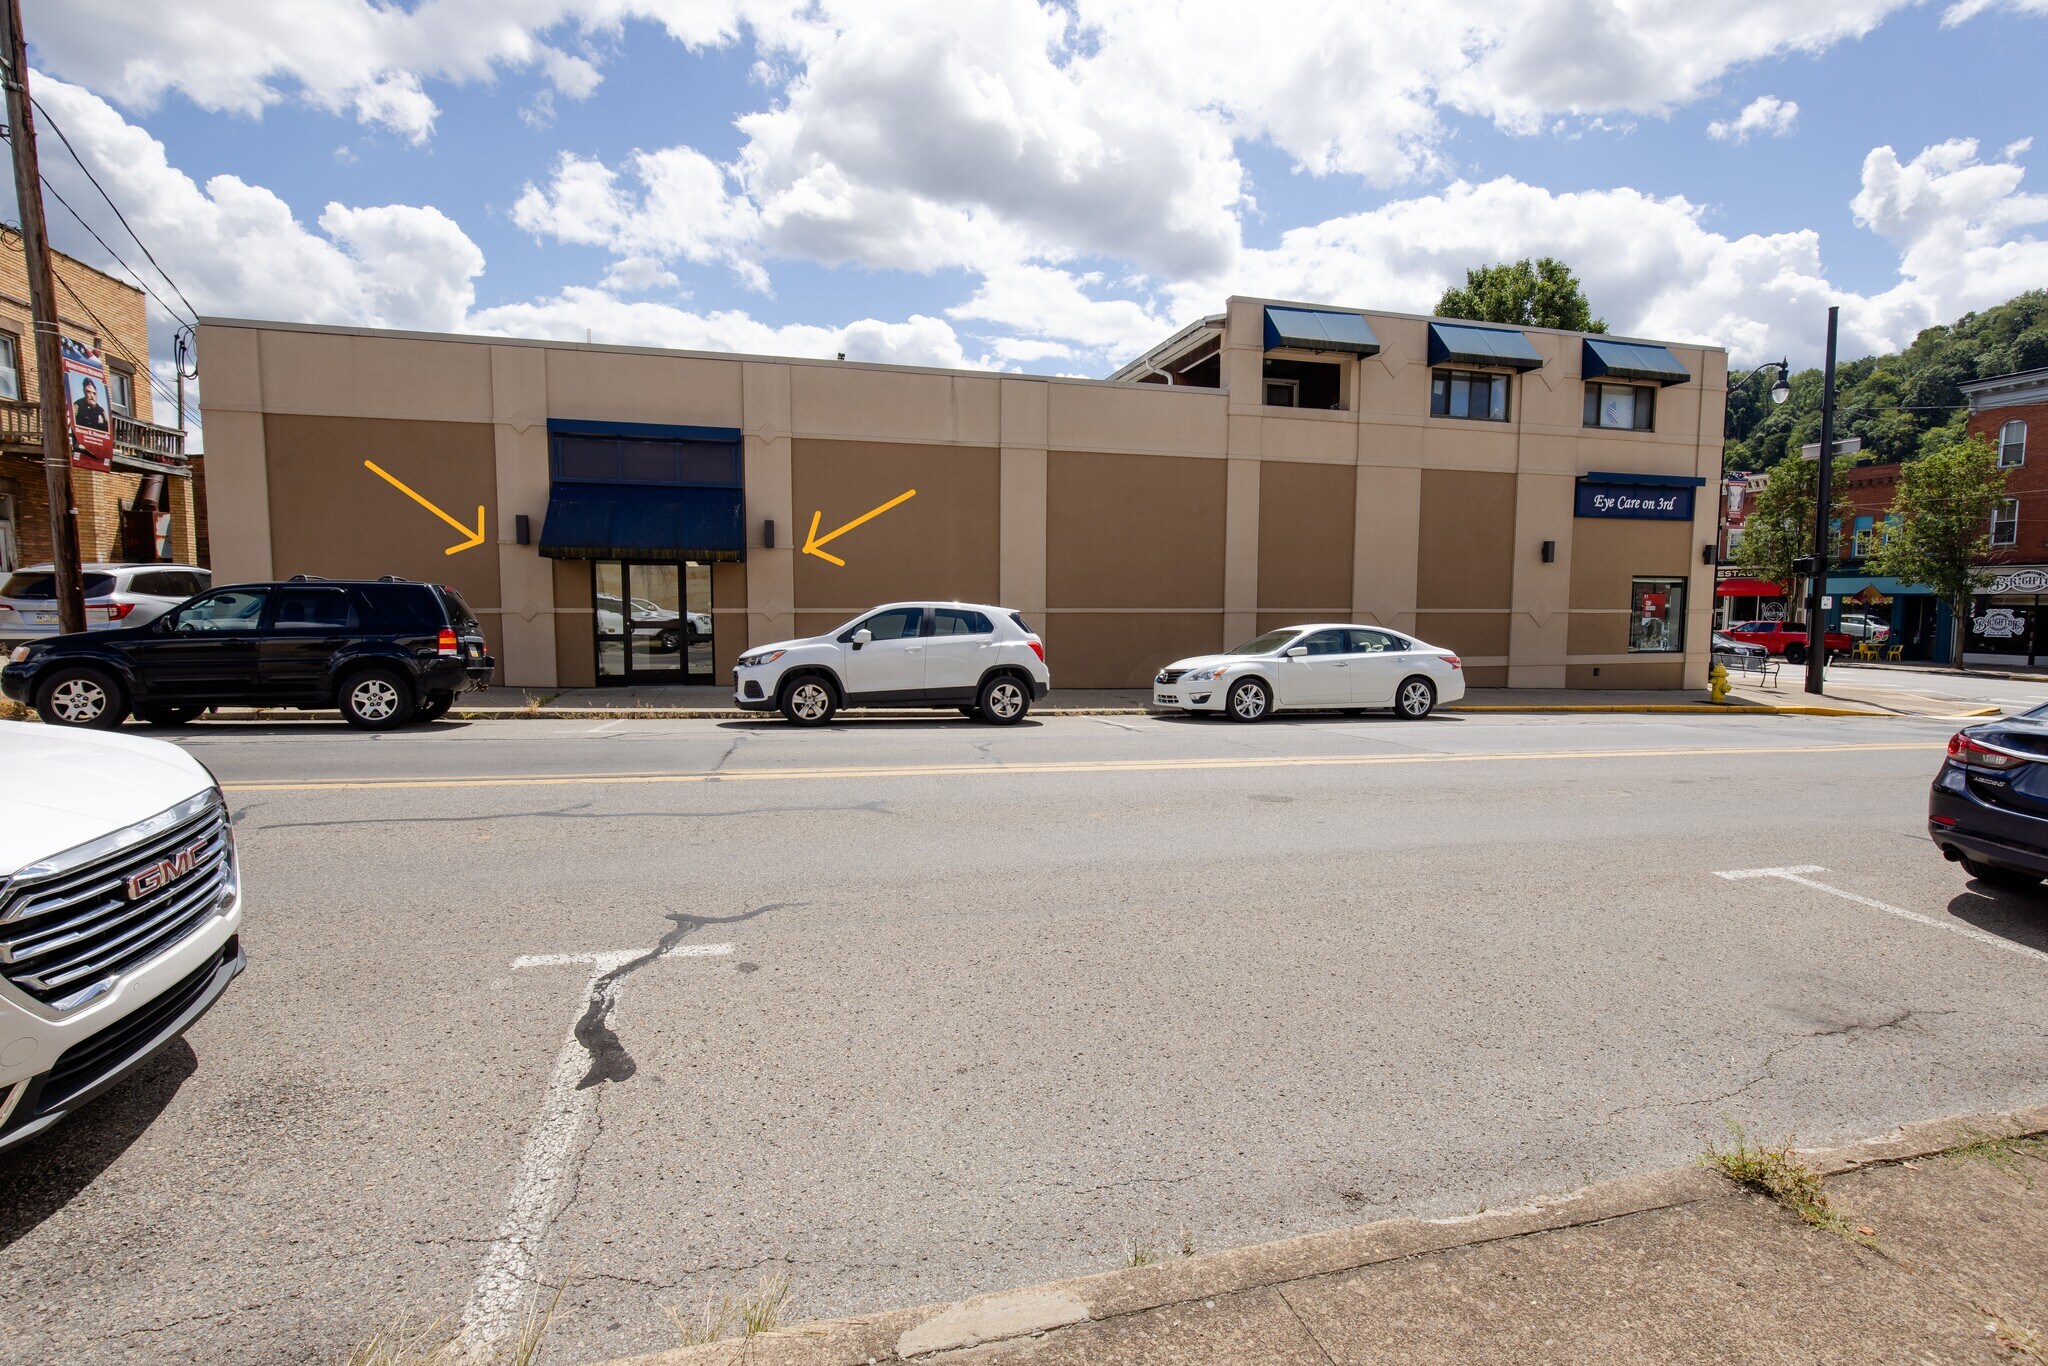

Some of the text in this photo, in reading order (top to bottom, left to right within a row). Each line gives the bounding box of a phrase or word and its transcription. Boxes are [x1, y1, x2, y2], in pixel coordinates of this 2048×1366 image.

[1594, 494, 1676, 512] Eye Care on 3rd
[127, 836, 210, 900] GMC
